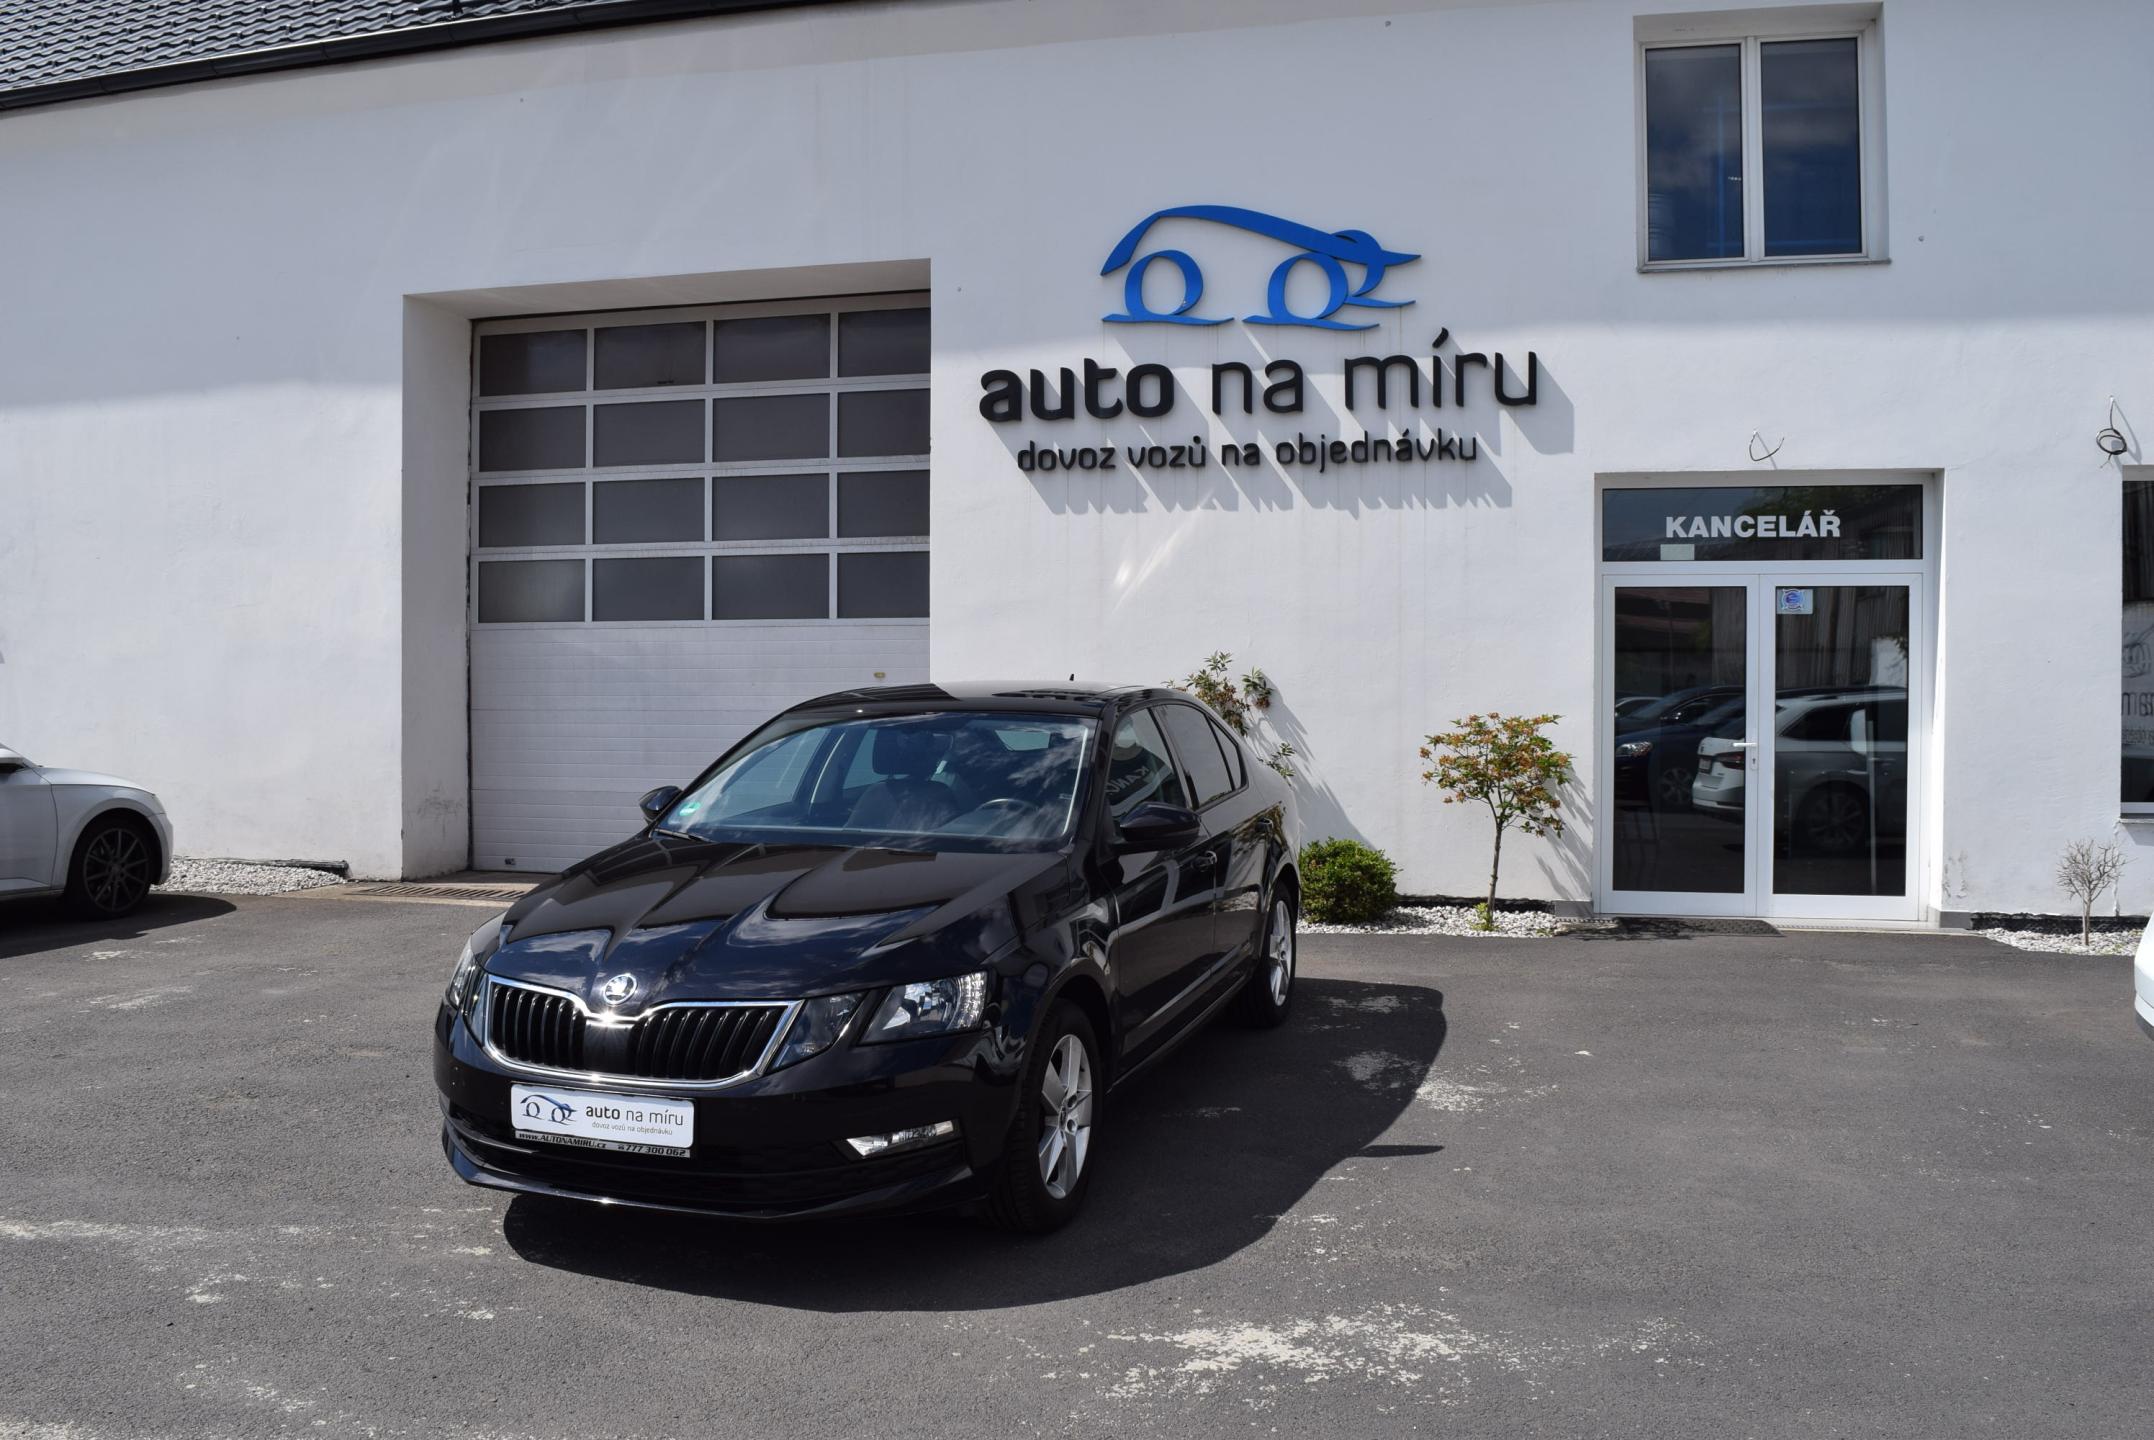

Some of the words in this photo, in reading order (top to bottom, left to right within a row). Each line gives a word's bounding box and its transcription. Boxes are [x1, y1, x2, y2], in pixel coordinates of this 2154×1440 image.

[979, 358, 1175, 424] auto
[1211, 359, 1304, 416] na
[1344, 327, 1538, 411] míru
[1017, 440, 1117, 473] dovoz
[1127, 435, 1207, 470] vozů
[1221, 441, 1261, 467] na
[1275, 428, 1477, 474] objednávku
[1666, 509, 1841, 538] KANCELÁŘ
[585, 1105, 621, 1120] auto
[626, 1110, 643, 1122] na
[649, 1109, 684, 1126] míru
[592, 1121, 610, 1130] dovoz
